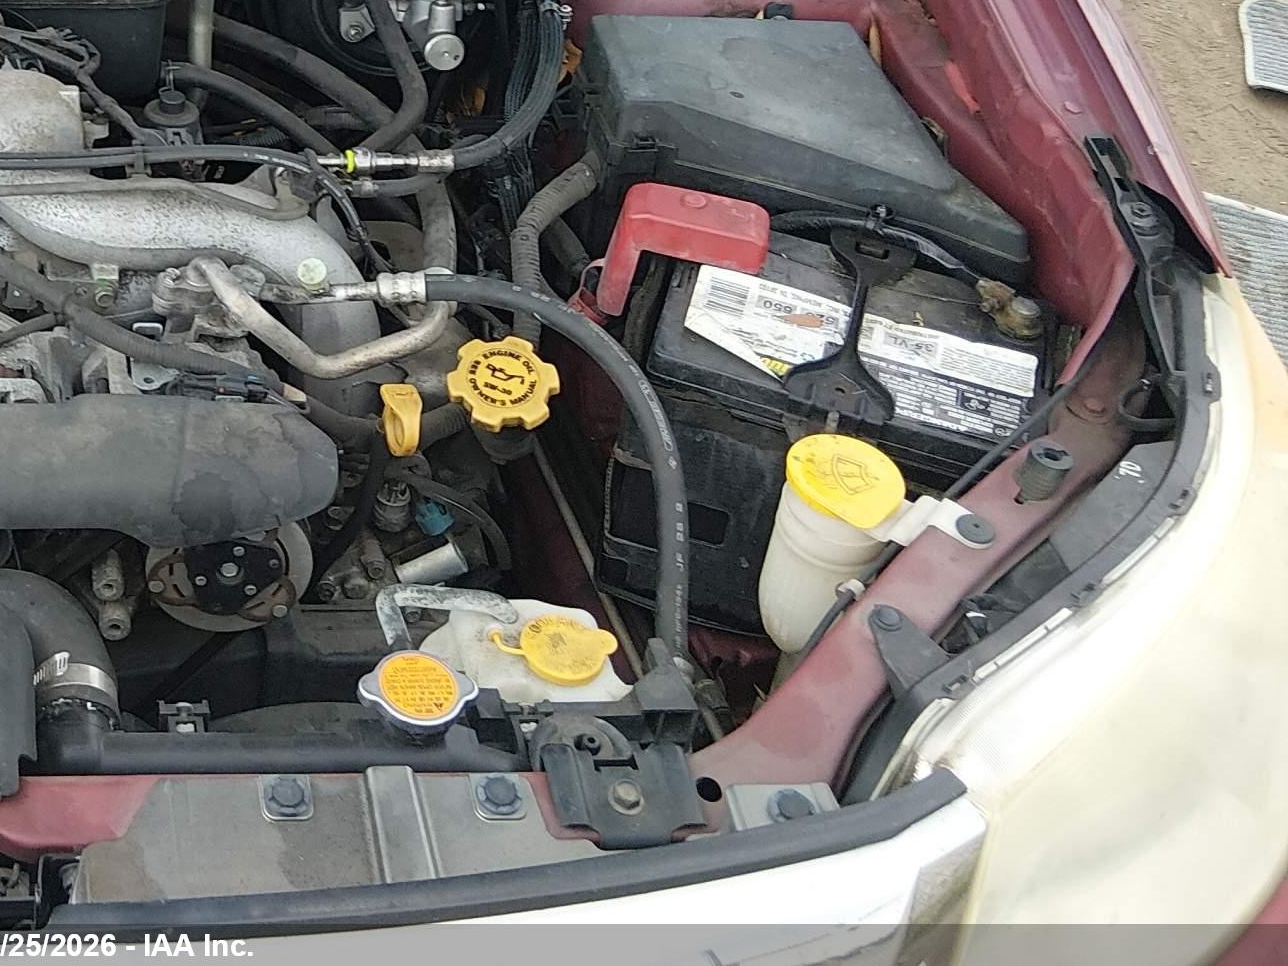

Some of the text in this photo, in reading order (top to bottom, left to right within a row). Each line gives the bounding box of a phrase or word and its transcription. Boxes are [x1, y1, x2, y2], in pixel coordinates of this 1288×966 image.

[763, 300, 793, 314] 650
[482, 350, 535, 375] ENGINE OIL
[509, 379, 537, 405] MANUAL
